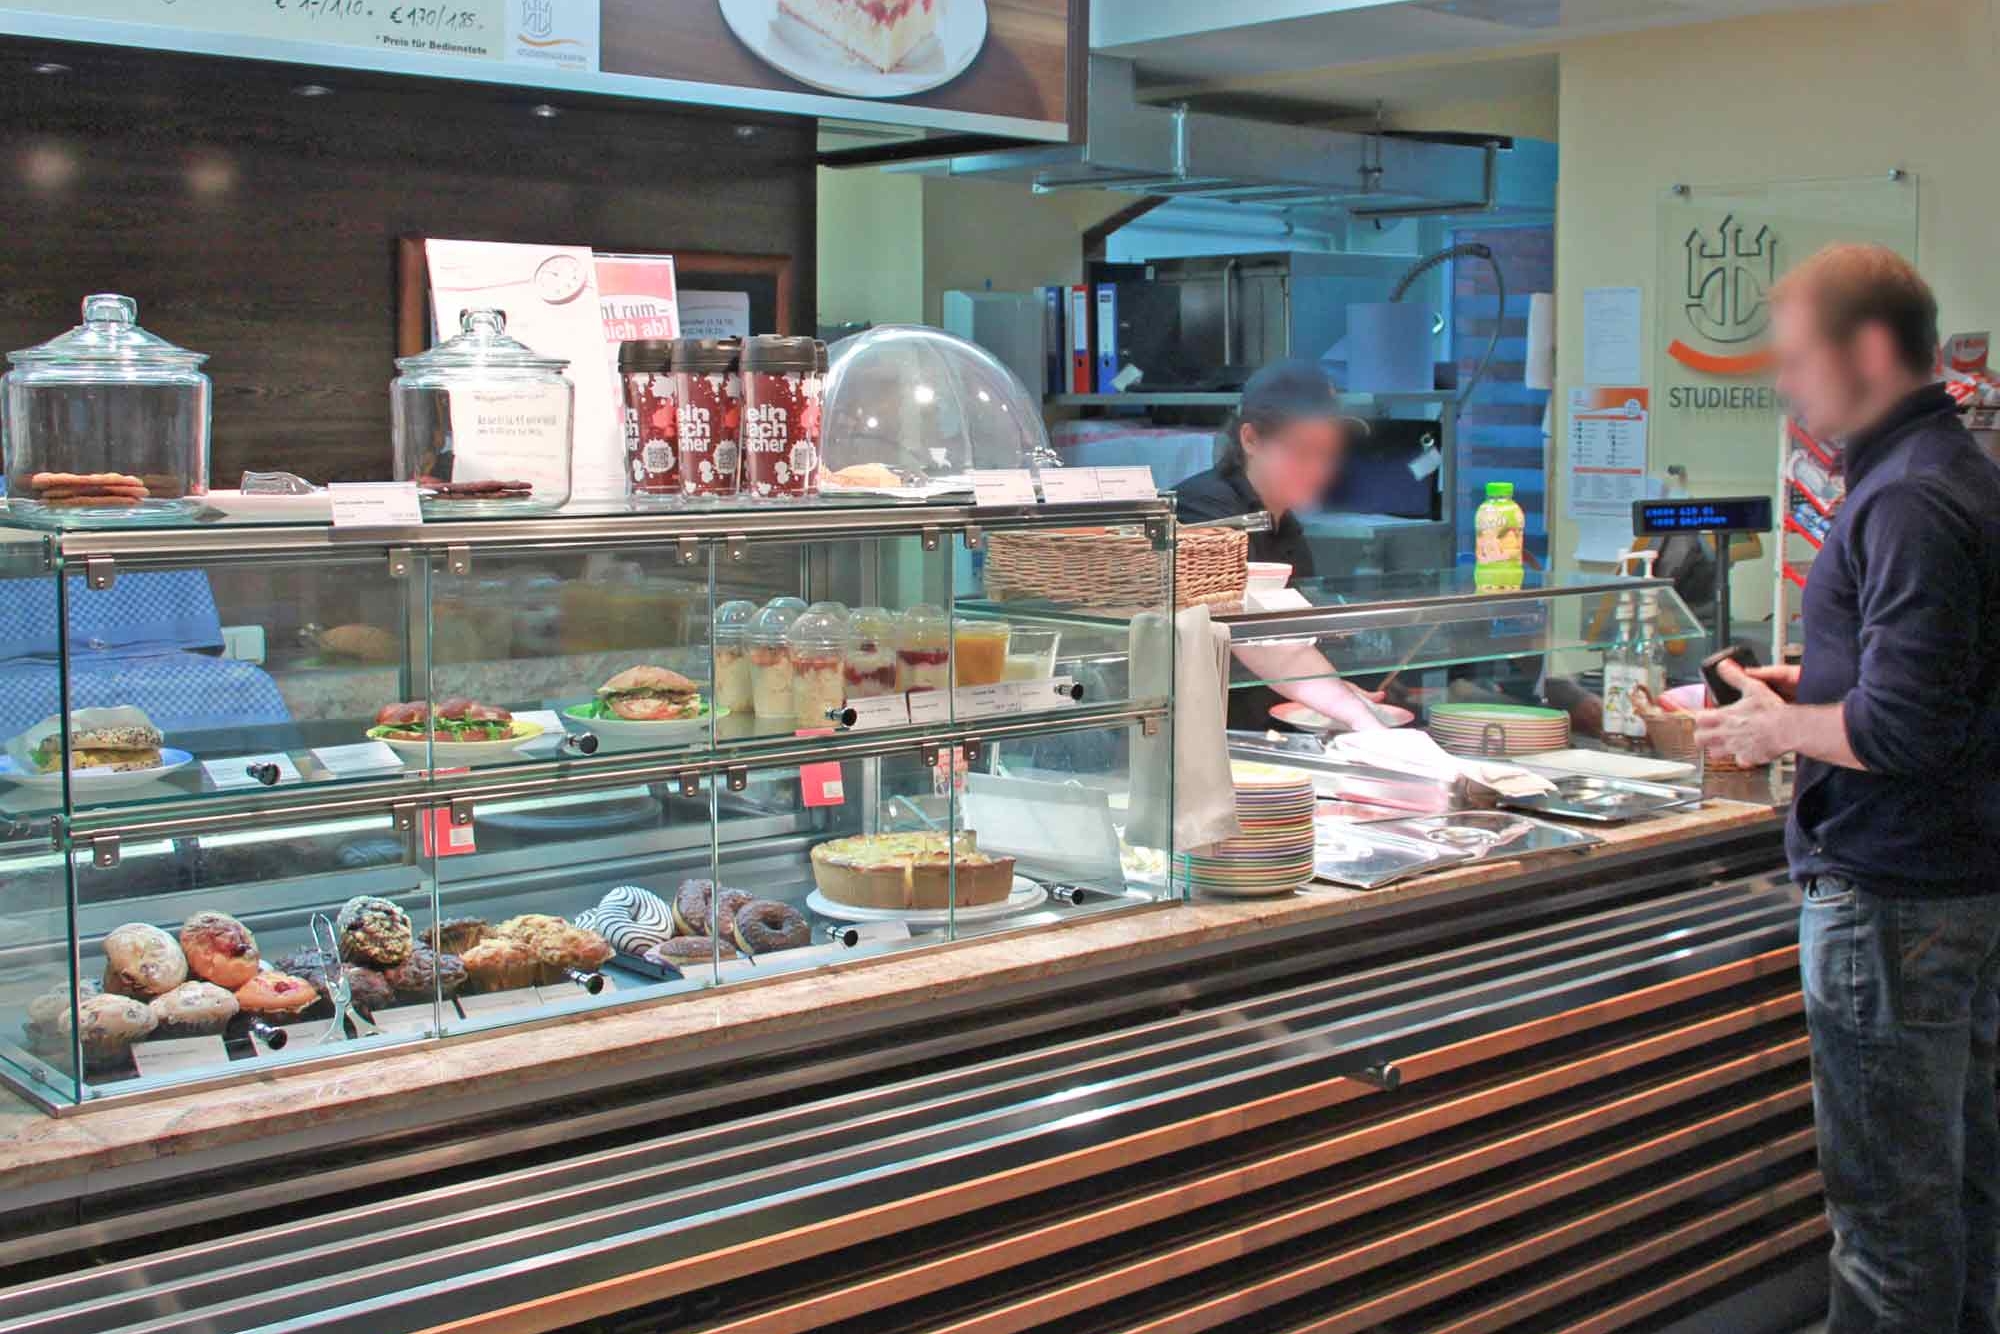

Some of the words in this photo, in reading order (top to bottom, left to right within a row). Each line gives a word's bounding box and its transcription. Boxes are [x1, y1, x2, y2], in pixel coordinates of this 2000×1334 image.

[383, 35, 409, 47] Preis
[411, 38, 426, 48] für
[428, 40, 487, 55] Bedienstete
